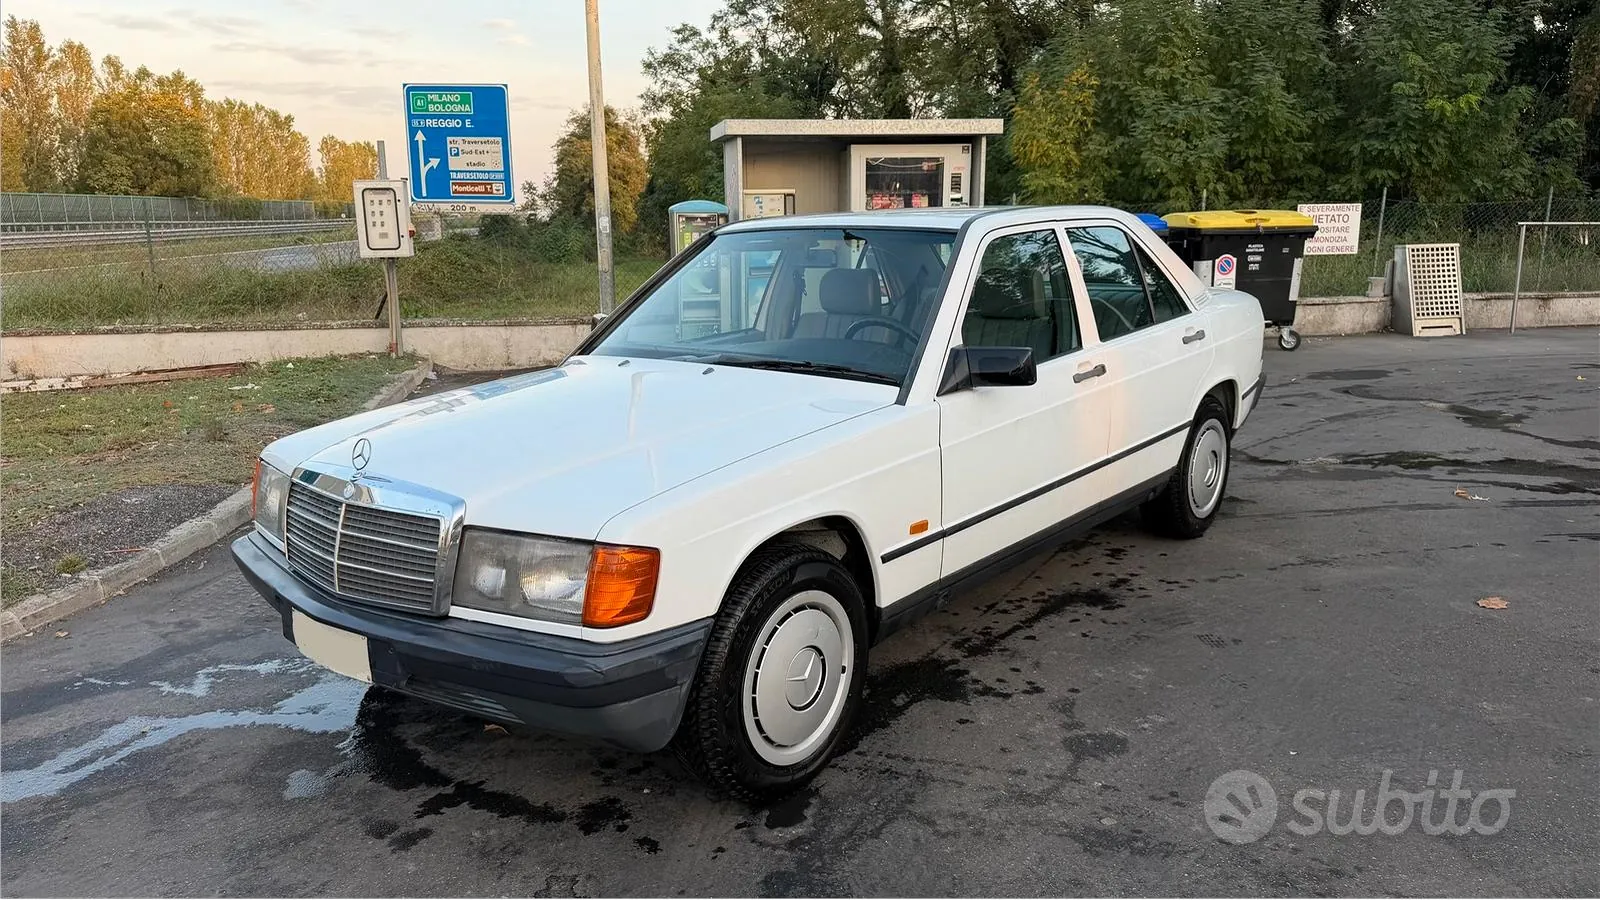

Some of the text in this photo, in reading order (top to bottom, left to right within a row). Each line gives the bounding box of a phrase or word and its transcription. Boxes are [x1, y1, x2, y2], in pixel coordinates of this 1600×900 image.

[427, 94, 460, 102] MILANO
[416, 99, 424, 107] A1
[428, 103, 471, 112] BOLOGNA
[425, 118, 462, 128] REGGIO
[465, 118, 475, 128] E.
[462, 138, 501, 146] Traversetolo
[450, 171, 489, 180] TRAVERSETOLO
[452, 183, 485, 193] Monticelli
[450, 204, 467, 212] 200
[1307, 204, 1360, 213] SEVERAMENTE
[1325, 245, 1355, 253] GENERE
